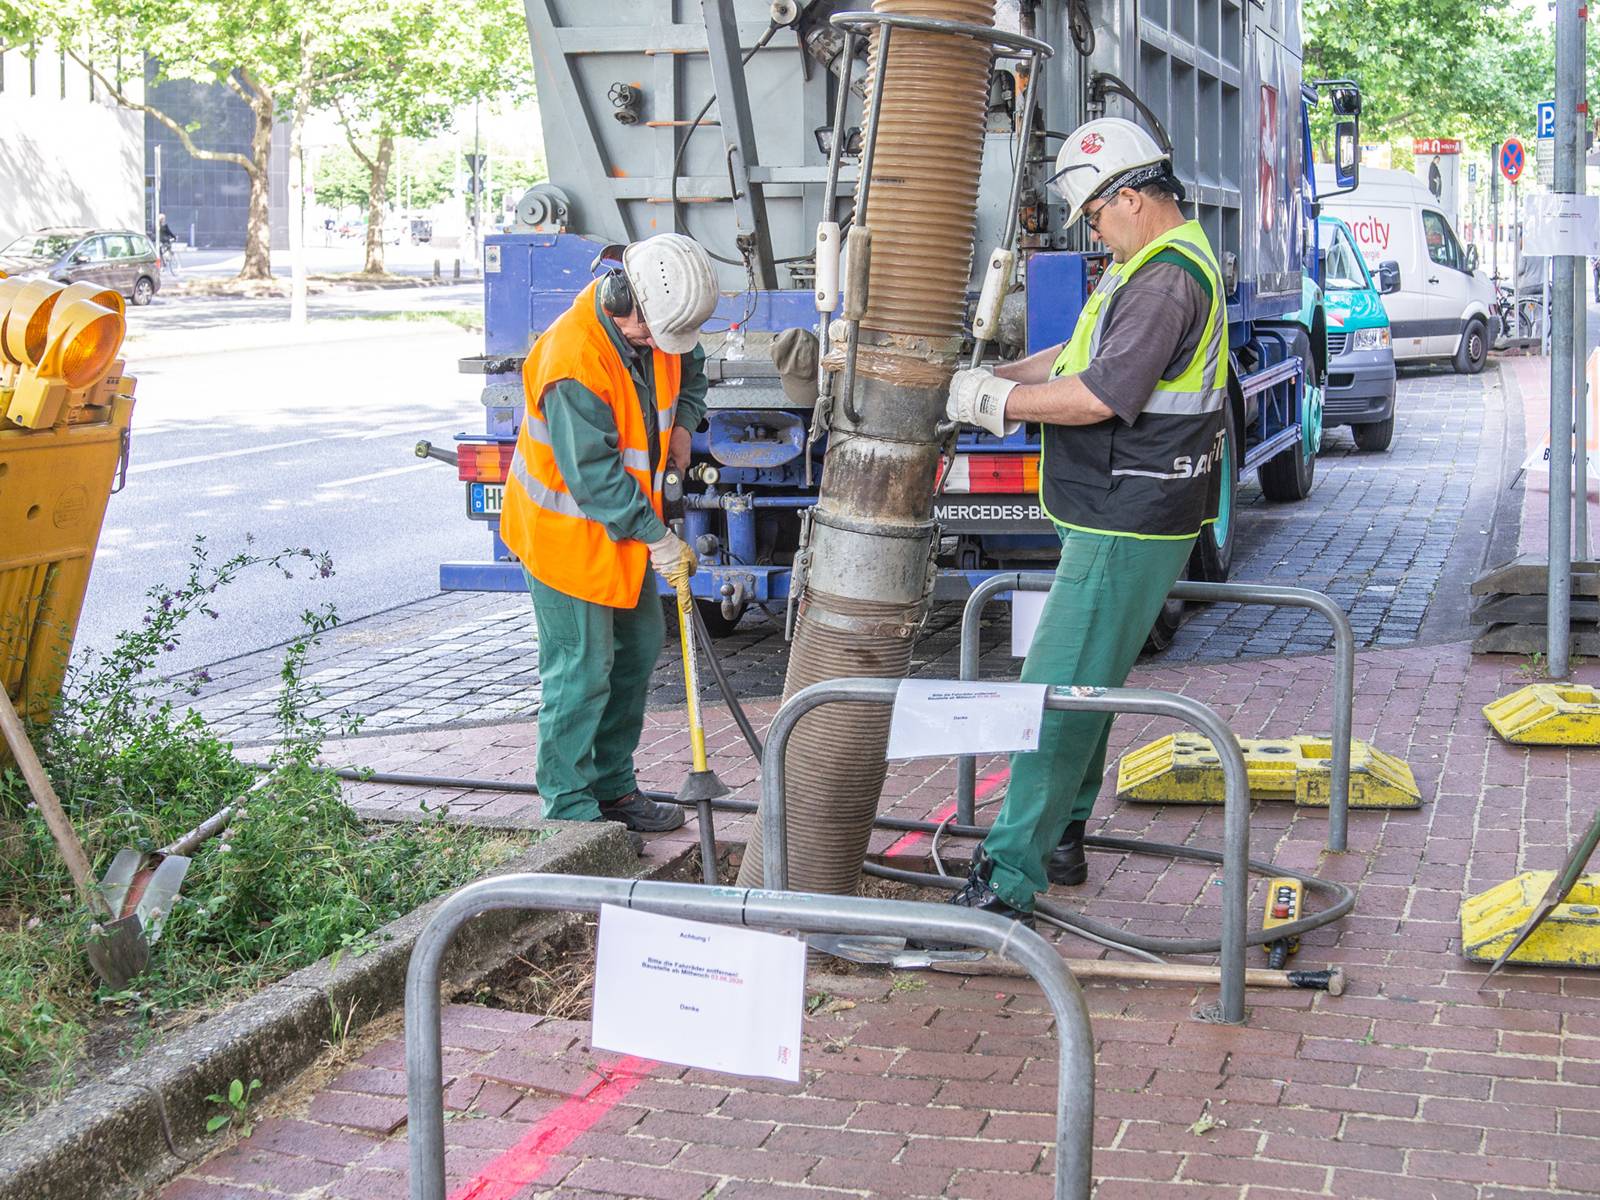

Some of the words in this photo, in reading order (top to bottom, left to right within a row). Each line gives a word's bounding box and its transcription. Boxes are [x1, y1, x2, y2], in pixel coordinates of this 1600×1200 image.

[1542, 106, 1555, 135] P
[475, 500, 482, 508] D
[679, 1004, 700, 1012] Danke
